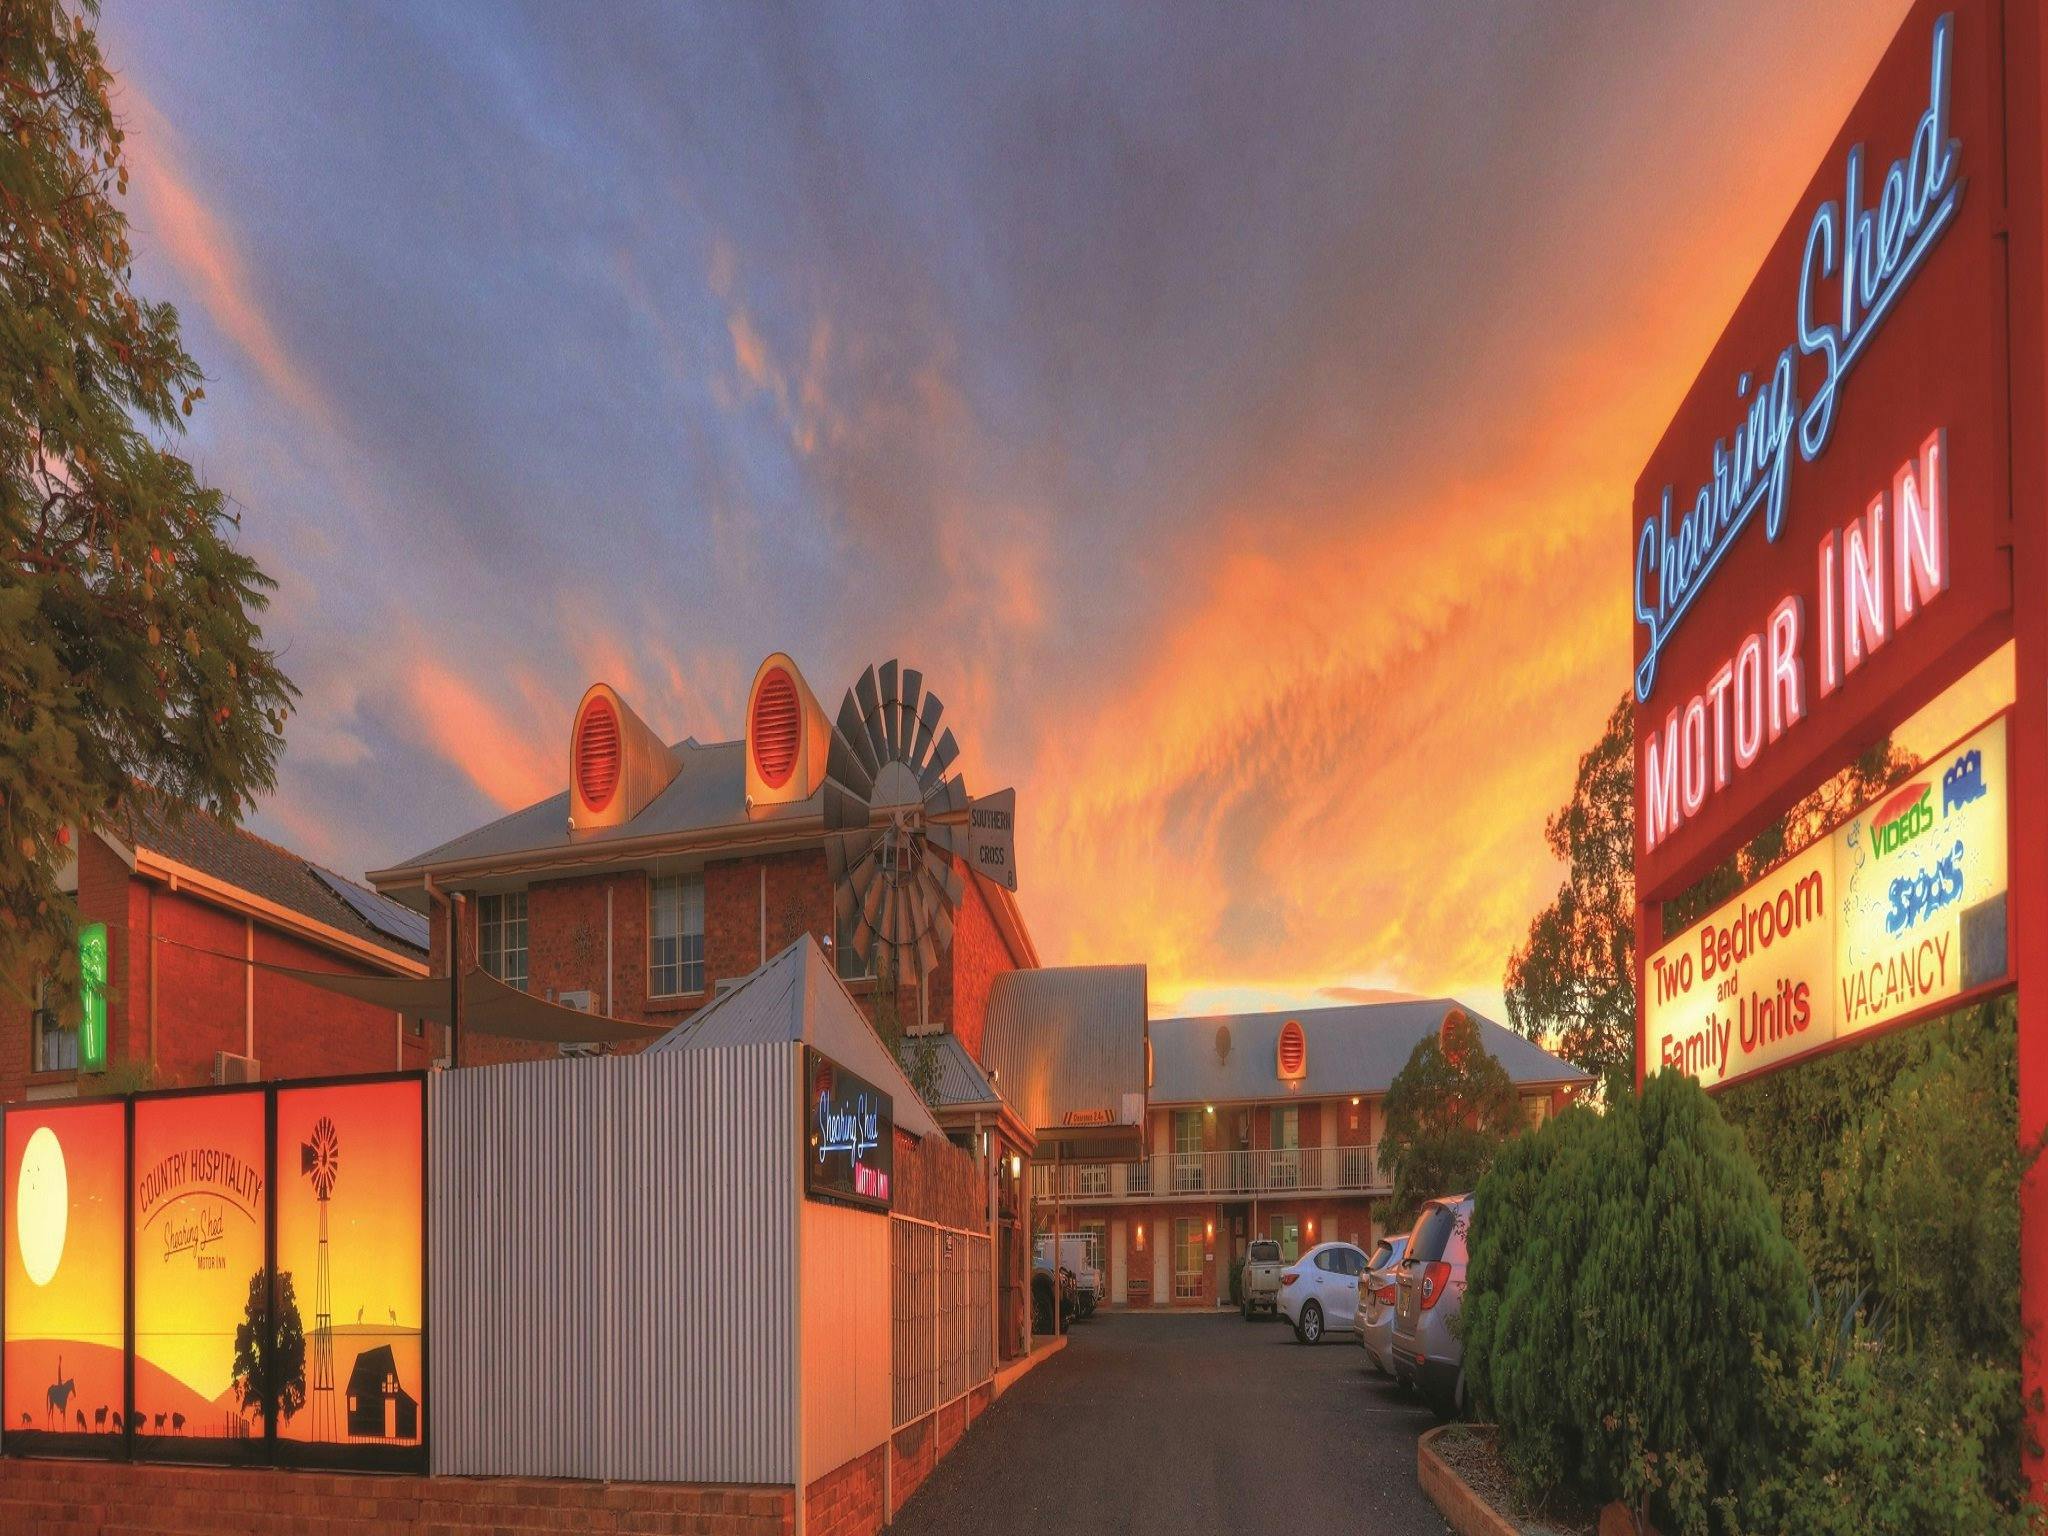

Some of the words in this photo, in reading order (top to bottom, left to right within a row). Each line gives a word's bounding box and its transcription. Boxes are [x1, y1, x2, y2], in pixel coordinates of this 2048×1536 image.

[1635, 344, 1796, 703] Shearing
[1797, 12, 1968, 462] Shed
[1645, 595, 1806, 855] MOTOR
[1819, 427, 1948, 699] INN
[971, 808, 1011, 830] SOUTHERN
[1942, 749, 1987, 819] POOL
[980, 845, 1005, 866] CROSS
[1870, 783, 1934, 860] VIDEOS
[1653, 952, 1693, 1006] Two
[1700, 870, 1824, 982] Bedroom
[1717, 969, 1738, 1002] and
[1842, 930, 1950, 1023] VACANCY
[1661, 1012, 1731, 1078] Family
[1739, 977, 1811, 1054] Units
[819, 1090, 858, 1168] Shearing
[857, 1092, 878, 1159] Shed
[139, 1151, 187, 1213] COUNTRY
[191, 1149, 262, 1208] HOSPITALITY
[855, 1162, 877, 1197] MOTOR
[164, 1218, 199, 1263] Shearing
[200, 1202, 224, 1251] Shed
[197, 1257, 215, 1270] MOTOR
